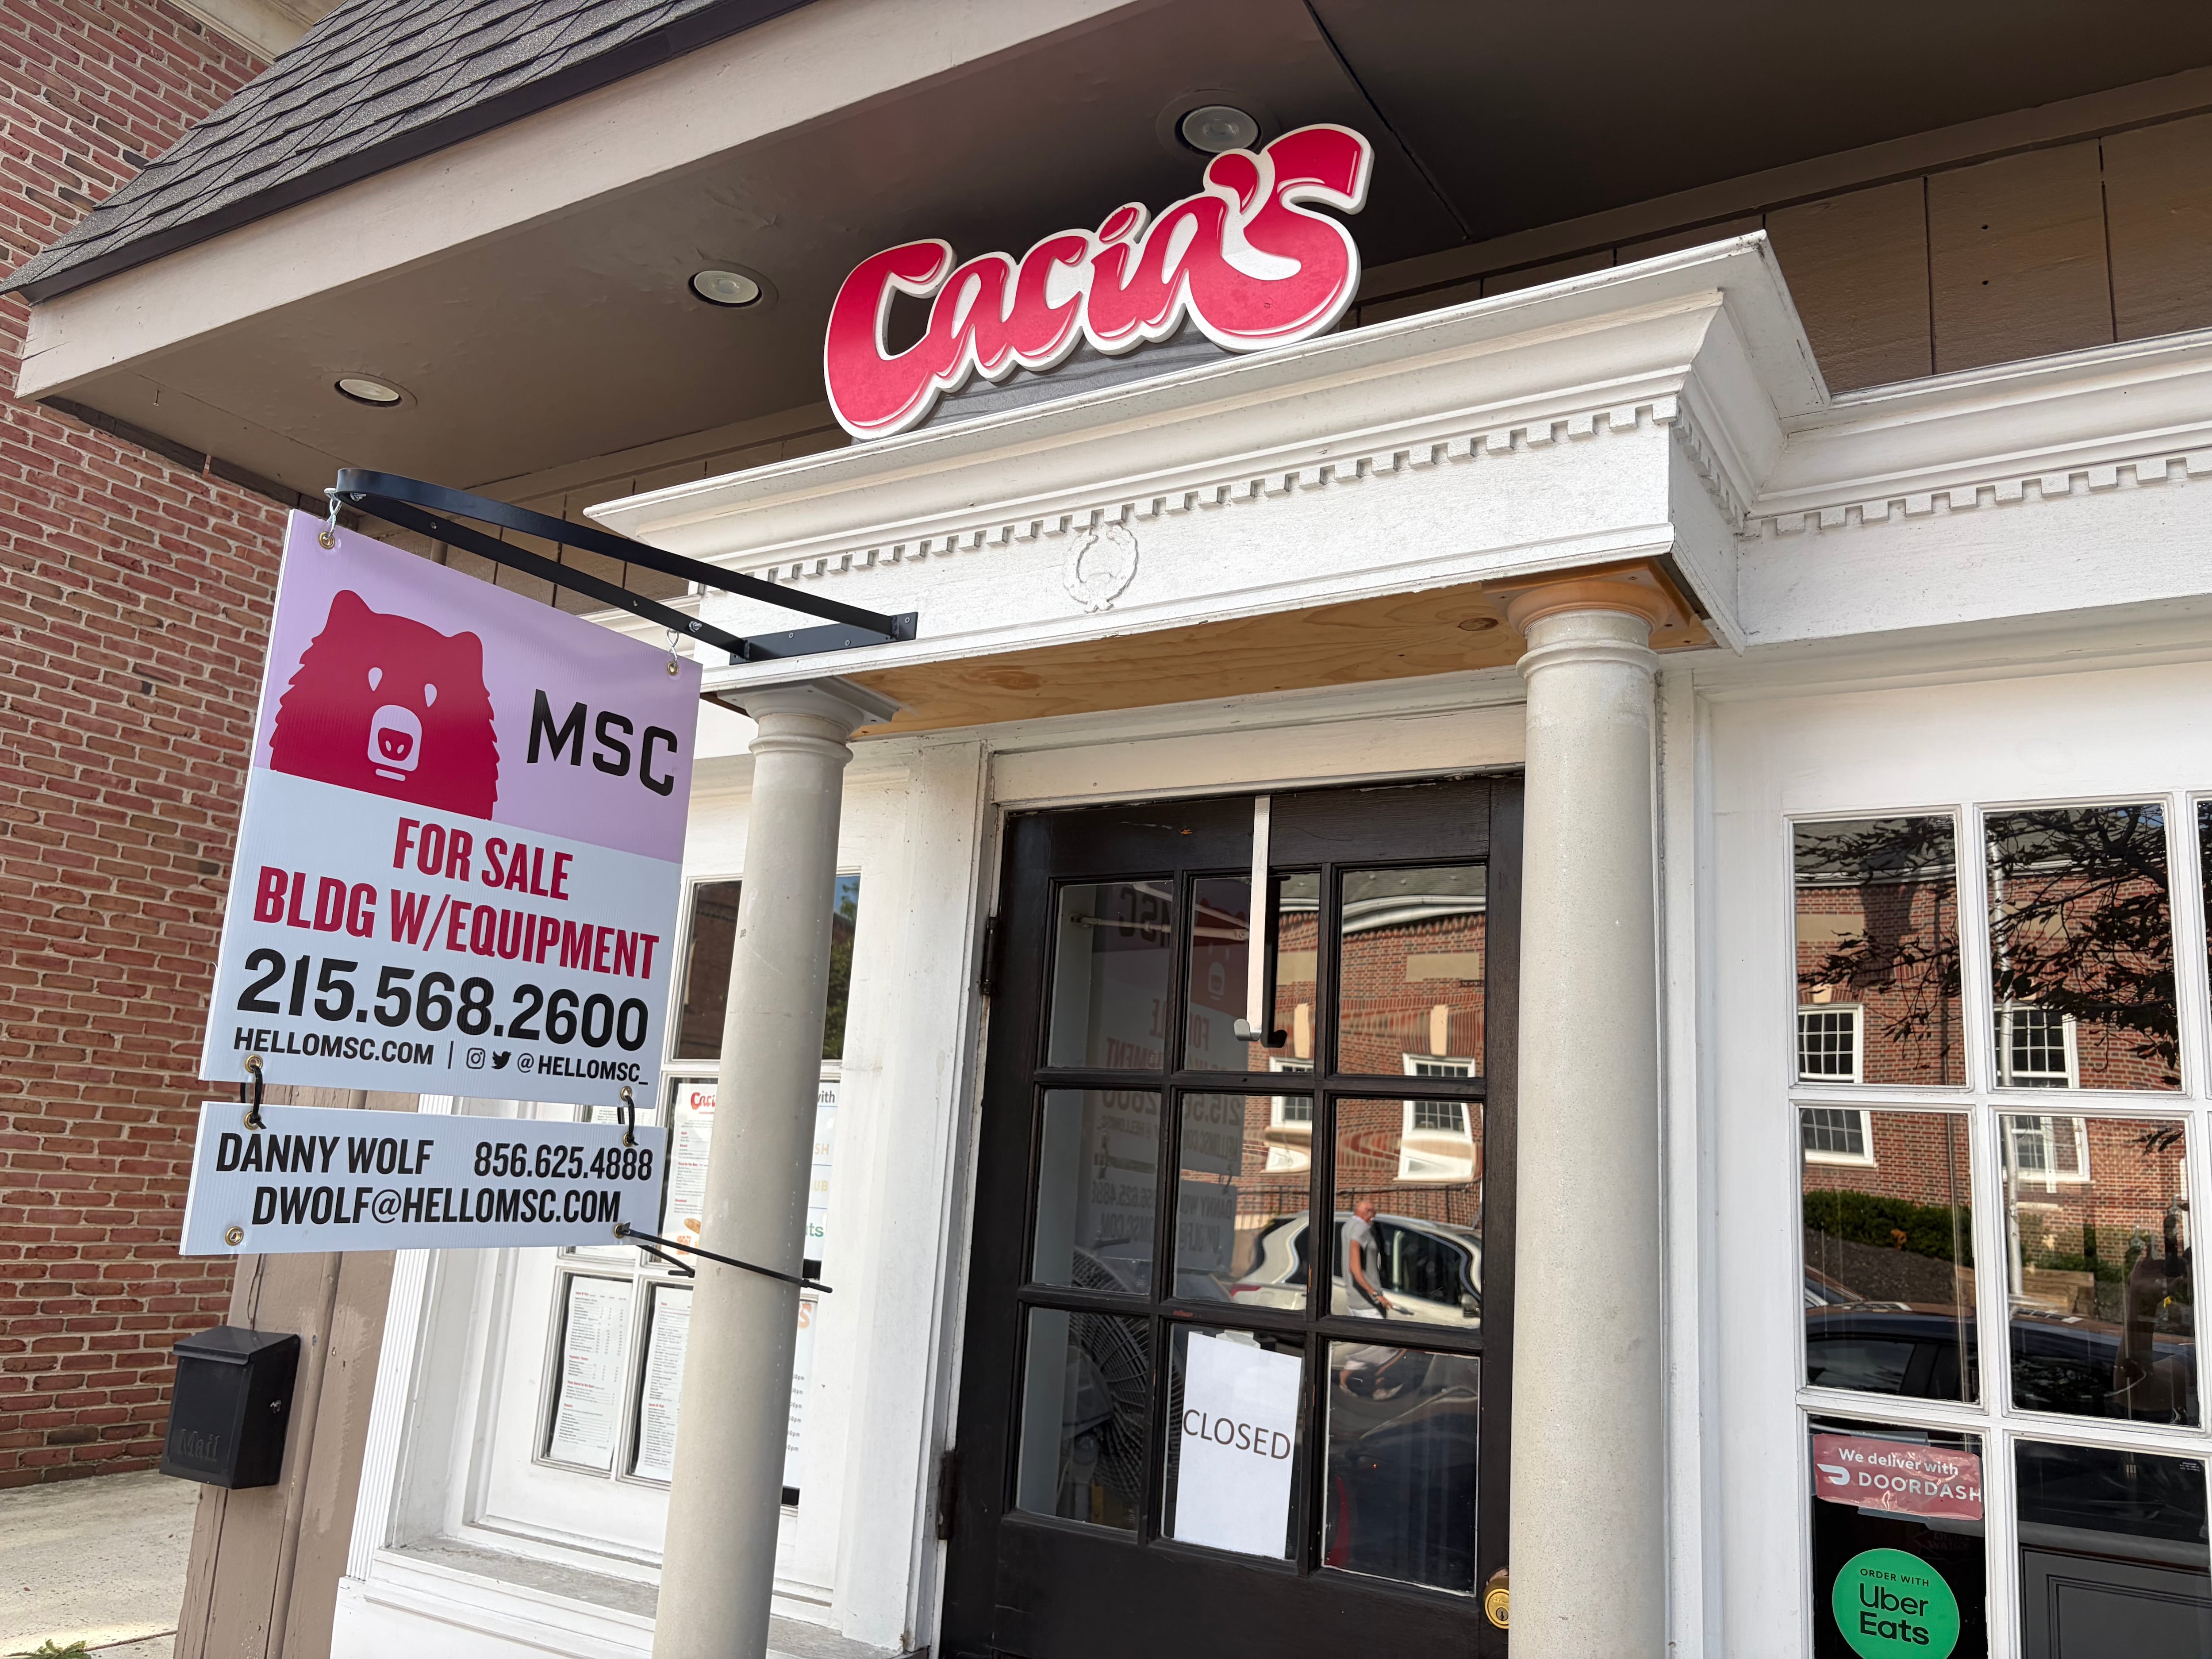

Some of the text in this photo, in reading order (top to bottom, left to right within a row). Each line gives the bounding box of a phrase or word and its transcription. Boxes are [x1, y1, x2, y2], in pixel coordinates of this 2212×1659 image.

[825, 125, 1371, 439] Cacia's
[527, 688, 678, 796] MSC
[394, 817, 573, 901] FOR SALE
[253, 866, 659, 979] BLDG W/EQUIPMENT
[237, 948, 649, 1051] 215.568.2600
[234, 1026, 434, 1065] HELLOMSC.COM
[216, 1132, 340, 1173] DANNY
[348, 1137, 434, 1175] WOLF
[474, 1141, 653, 1181] 856.625.4888
[252, 1186, 621, 1225] DWOLF@HELLOMSC.COM
[178, 1428, 220, 1461] Mail
[1181, 1405, 1291, 1460] CLOSED
[1838, 1448, 1959, 1476] We deliver with
[1859, 1471, 1982, 1502] DOORDASH
[1860, 1568, 1929, 1587] ORDER WITH
[1859, 1582, 1929, 1617] Uber
[1859, 1610, 1930, 1646] Eats
